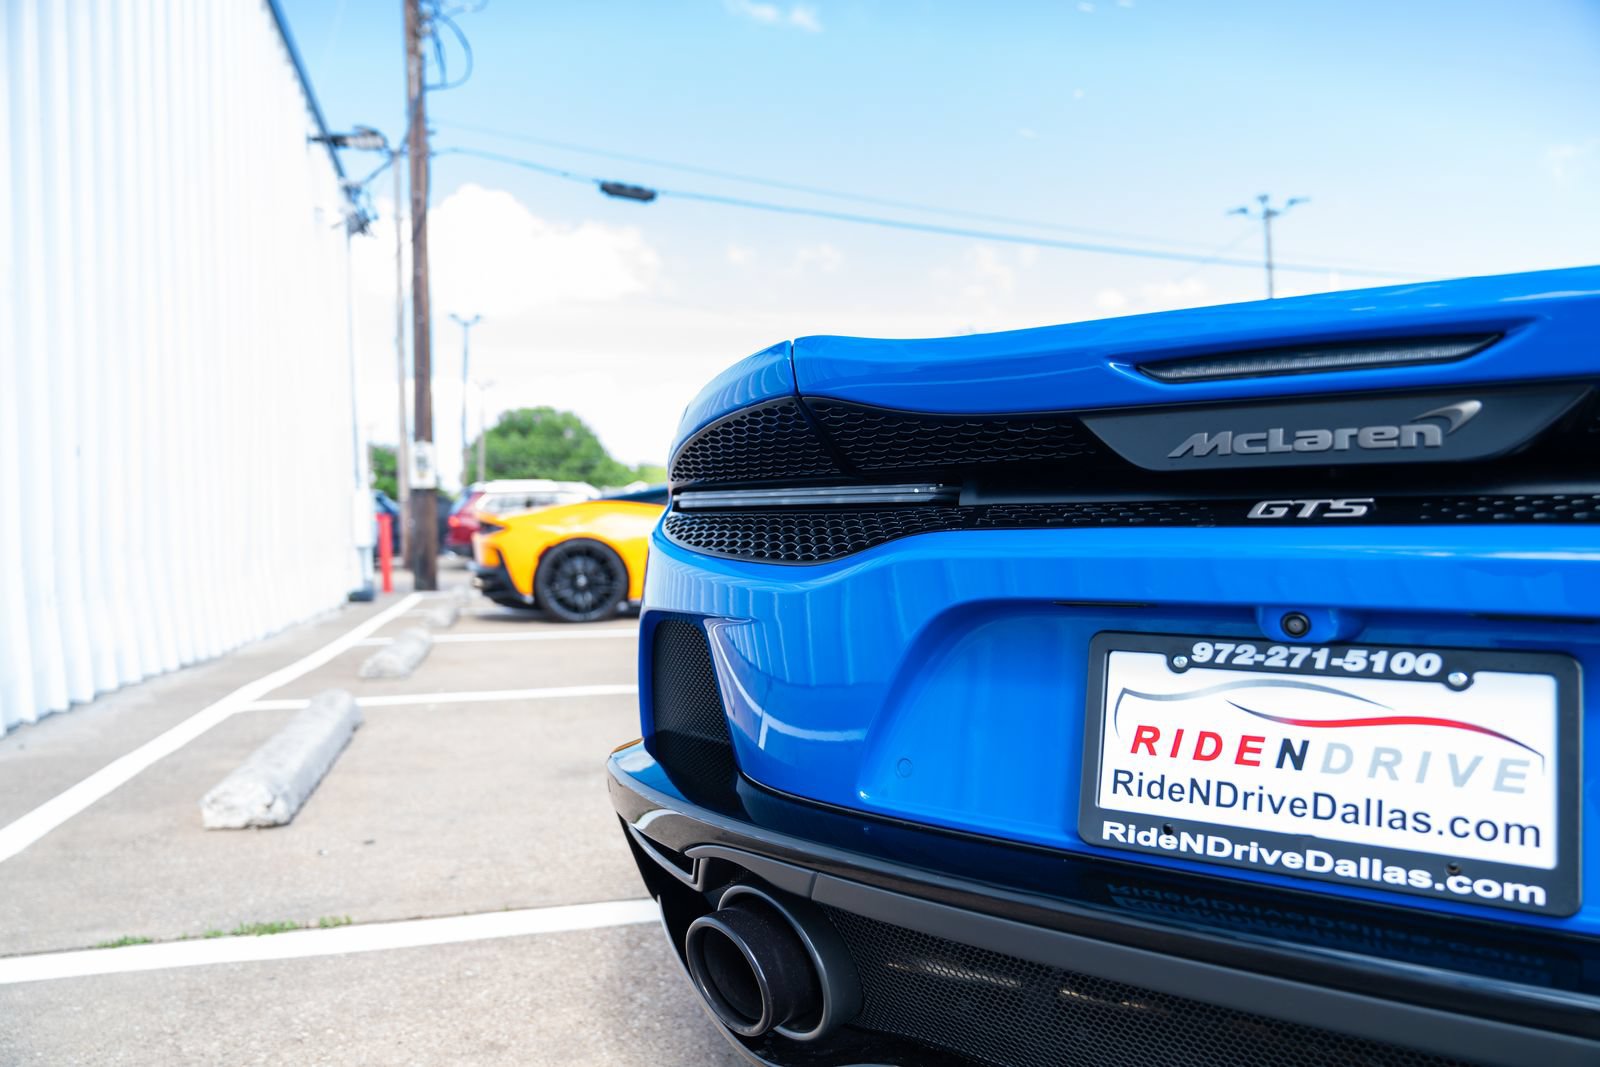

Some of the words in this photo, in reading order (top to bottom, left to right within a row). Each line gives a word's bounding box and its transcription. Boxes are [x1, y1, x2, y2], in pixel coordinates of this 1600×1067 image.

[1168, 423, 1442, 458] McLaren
[1247, 498, 1374, 519] GTS
[1191, 641, 1442, 677] 972-271-5100
[1112, 769, 1541, 848] RideNDriveDallas.com
[1102, 821, 1546, 907] RideNDriveDallas.com
